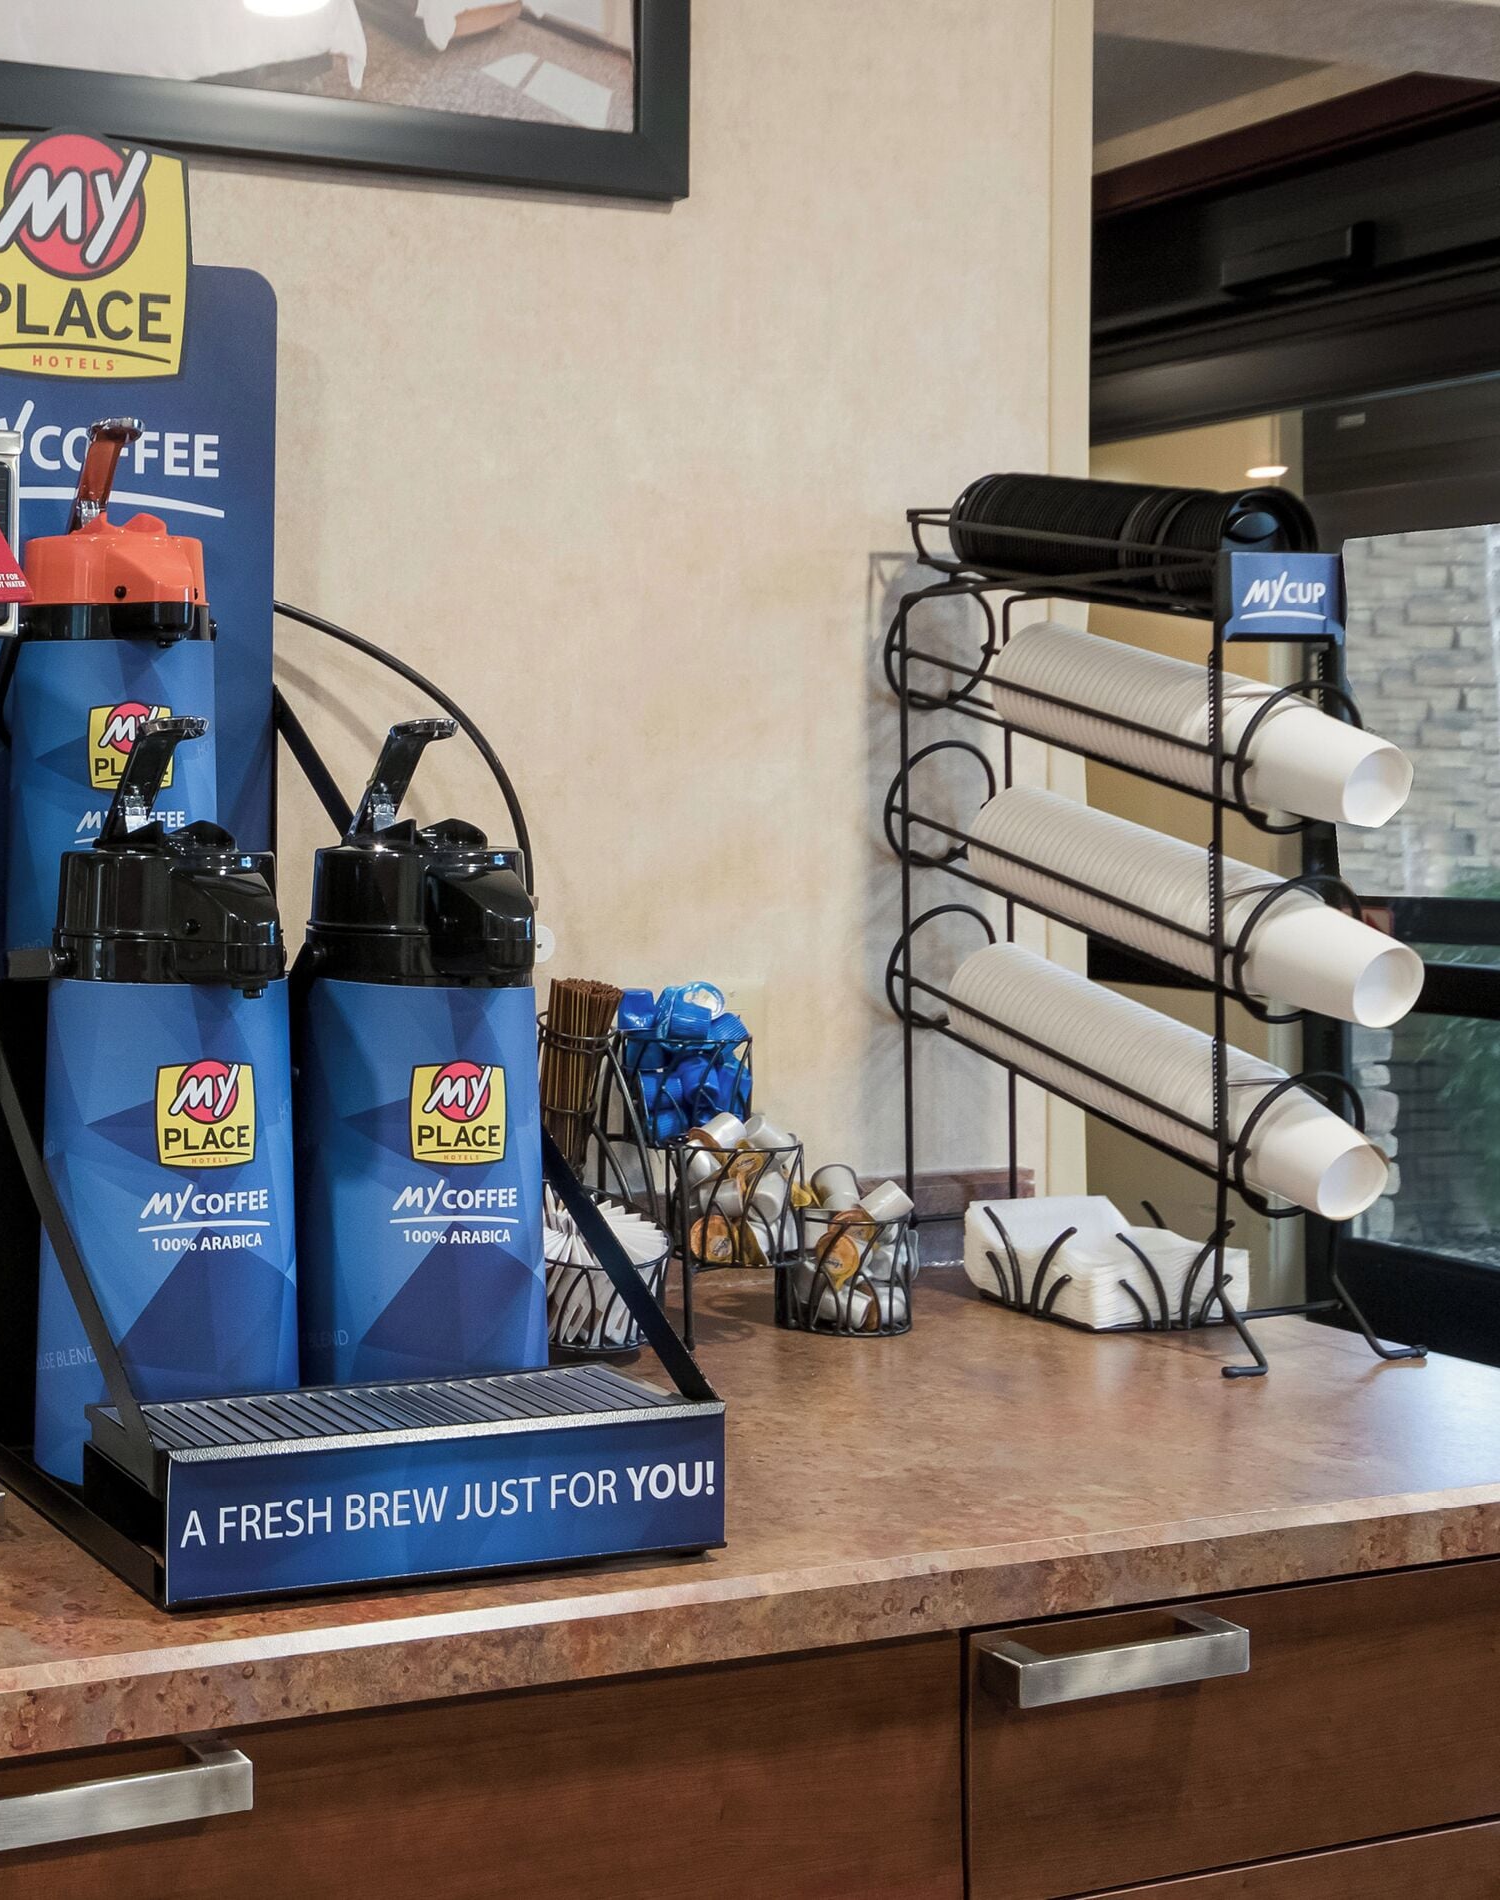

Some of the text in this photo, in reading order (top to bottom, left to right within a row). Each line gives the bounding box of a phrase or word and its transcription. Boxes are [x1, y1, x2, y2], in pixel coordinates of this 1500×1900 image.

[31, 353, 115, 372] HOTELS
[6, 580, 26, 588] WATER
[163, 1125, 250, 1150] PLACE
[417, 1125, 501, 1147] PLACE
[152, 1232, 262, 1252] 100% ARABICA
[403, 1229, 511, 1244] 100% ARABICA
[179, 1460, 715, 1548] A FRESH BREW JUST FOR YOU!
